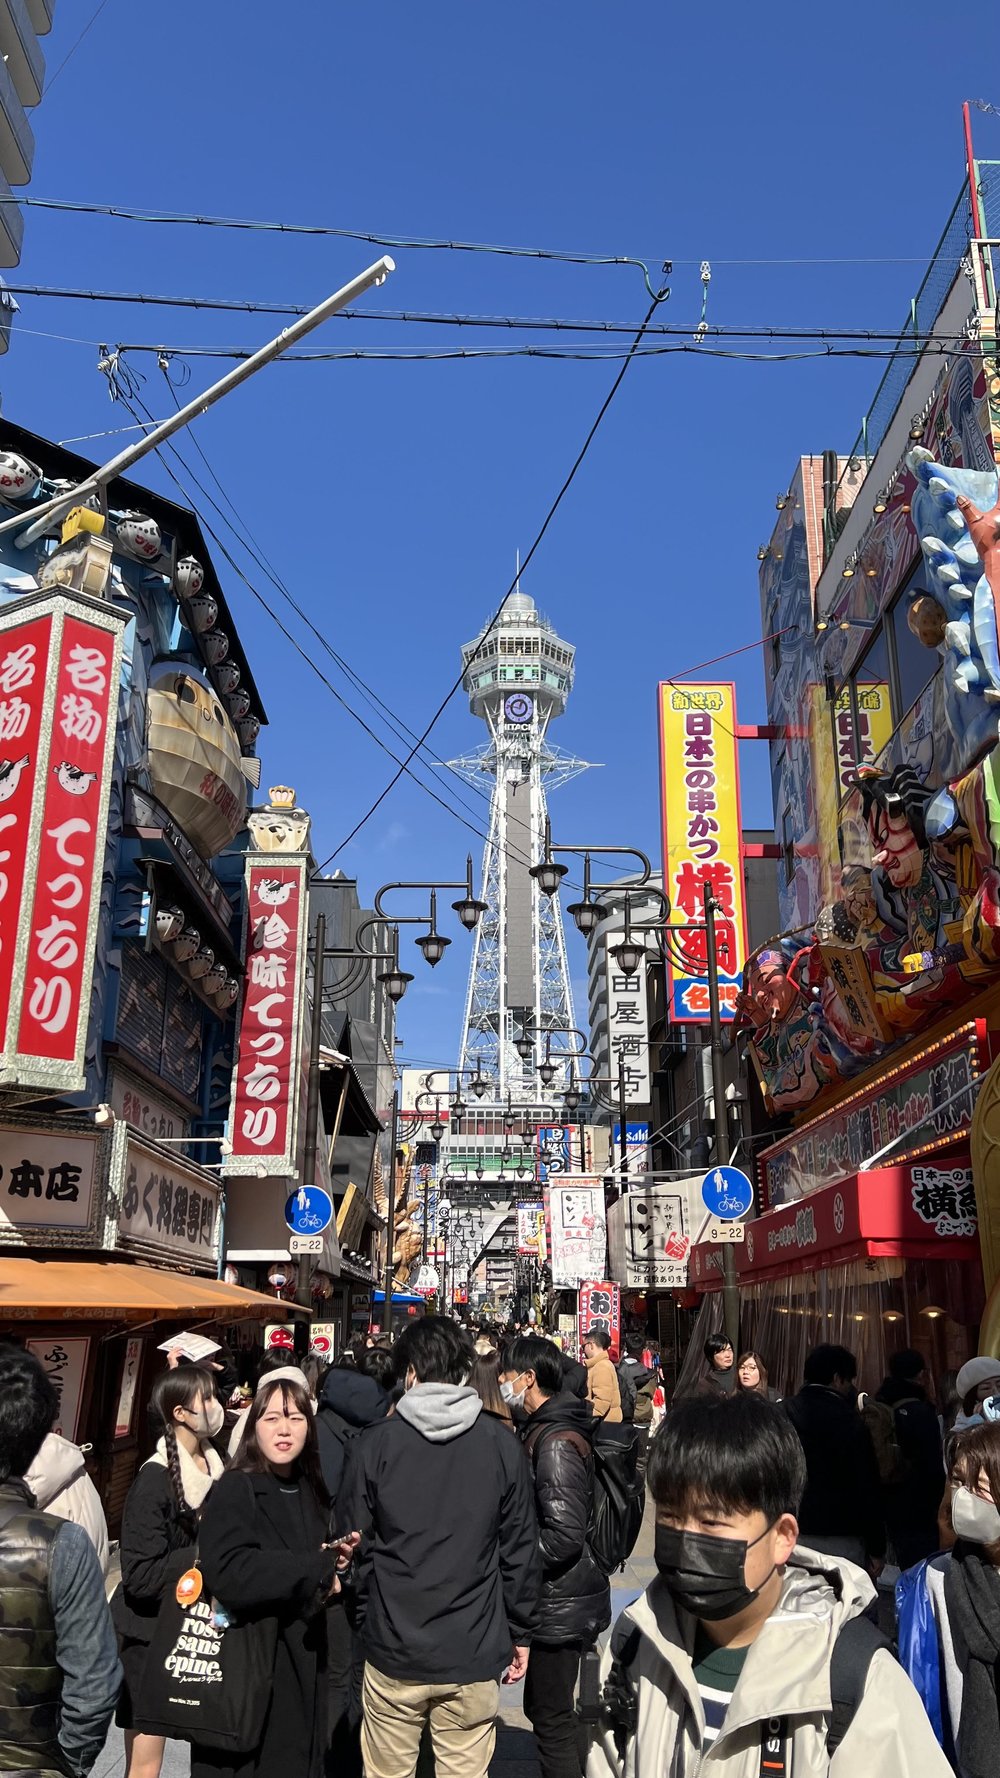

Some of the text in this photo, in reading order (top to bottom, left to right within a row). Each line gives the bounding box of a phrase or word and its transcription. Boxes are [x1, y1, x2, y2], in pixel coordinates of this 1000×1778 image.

[60, 644, 106, 744] 名物
[672, 690, 723, 711] 新世界
[685, 713, 719, 859] 日本一の串かつ
[676, 861, 737, 979] 横綱
[0, 1159, 82, 1201] 本店
[164, 1648, 223, 1678] épine.
[176, 1635, 222, 1656] sans
